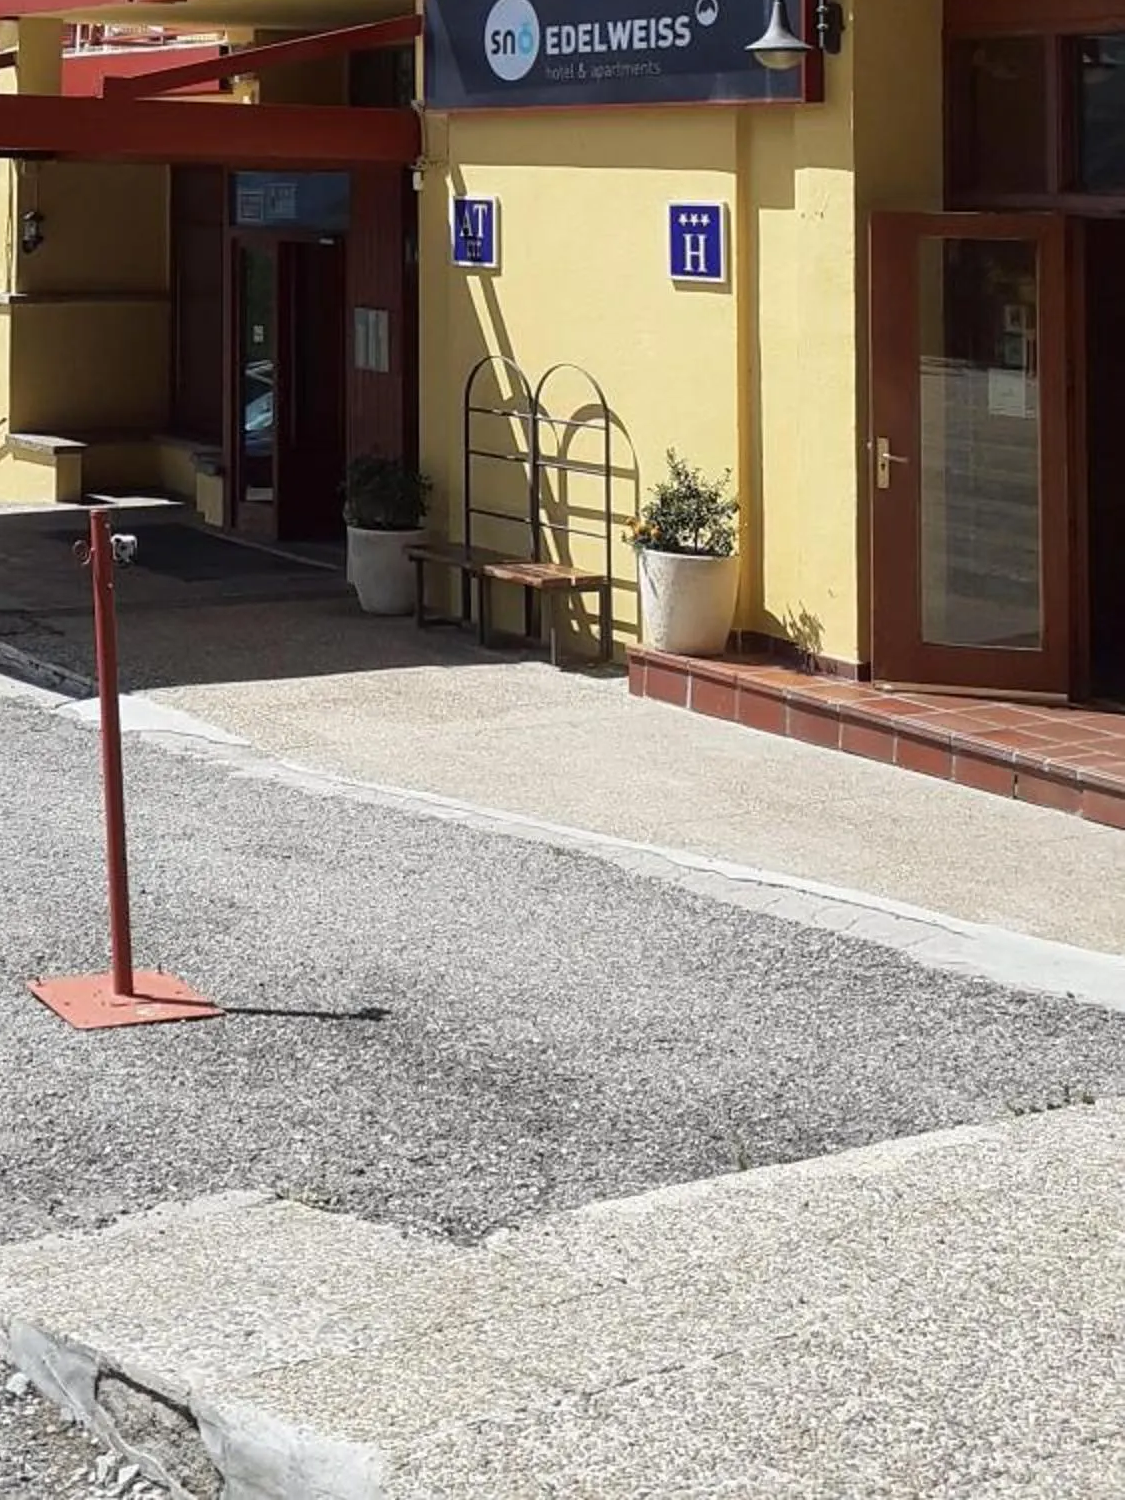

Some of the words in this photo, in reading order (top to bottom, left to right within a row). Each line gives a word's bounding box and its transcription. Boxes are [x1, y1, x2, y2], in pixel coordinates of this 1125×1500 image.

[545, 15, 691, 55] EDELWEISS
[460, 204, 488, 238] AT
[683, 234, 708, 273] H
